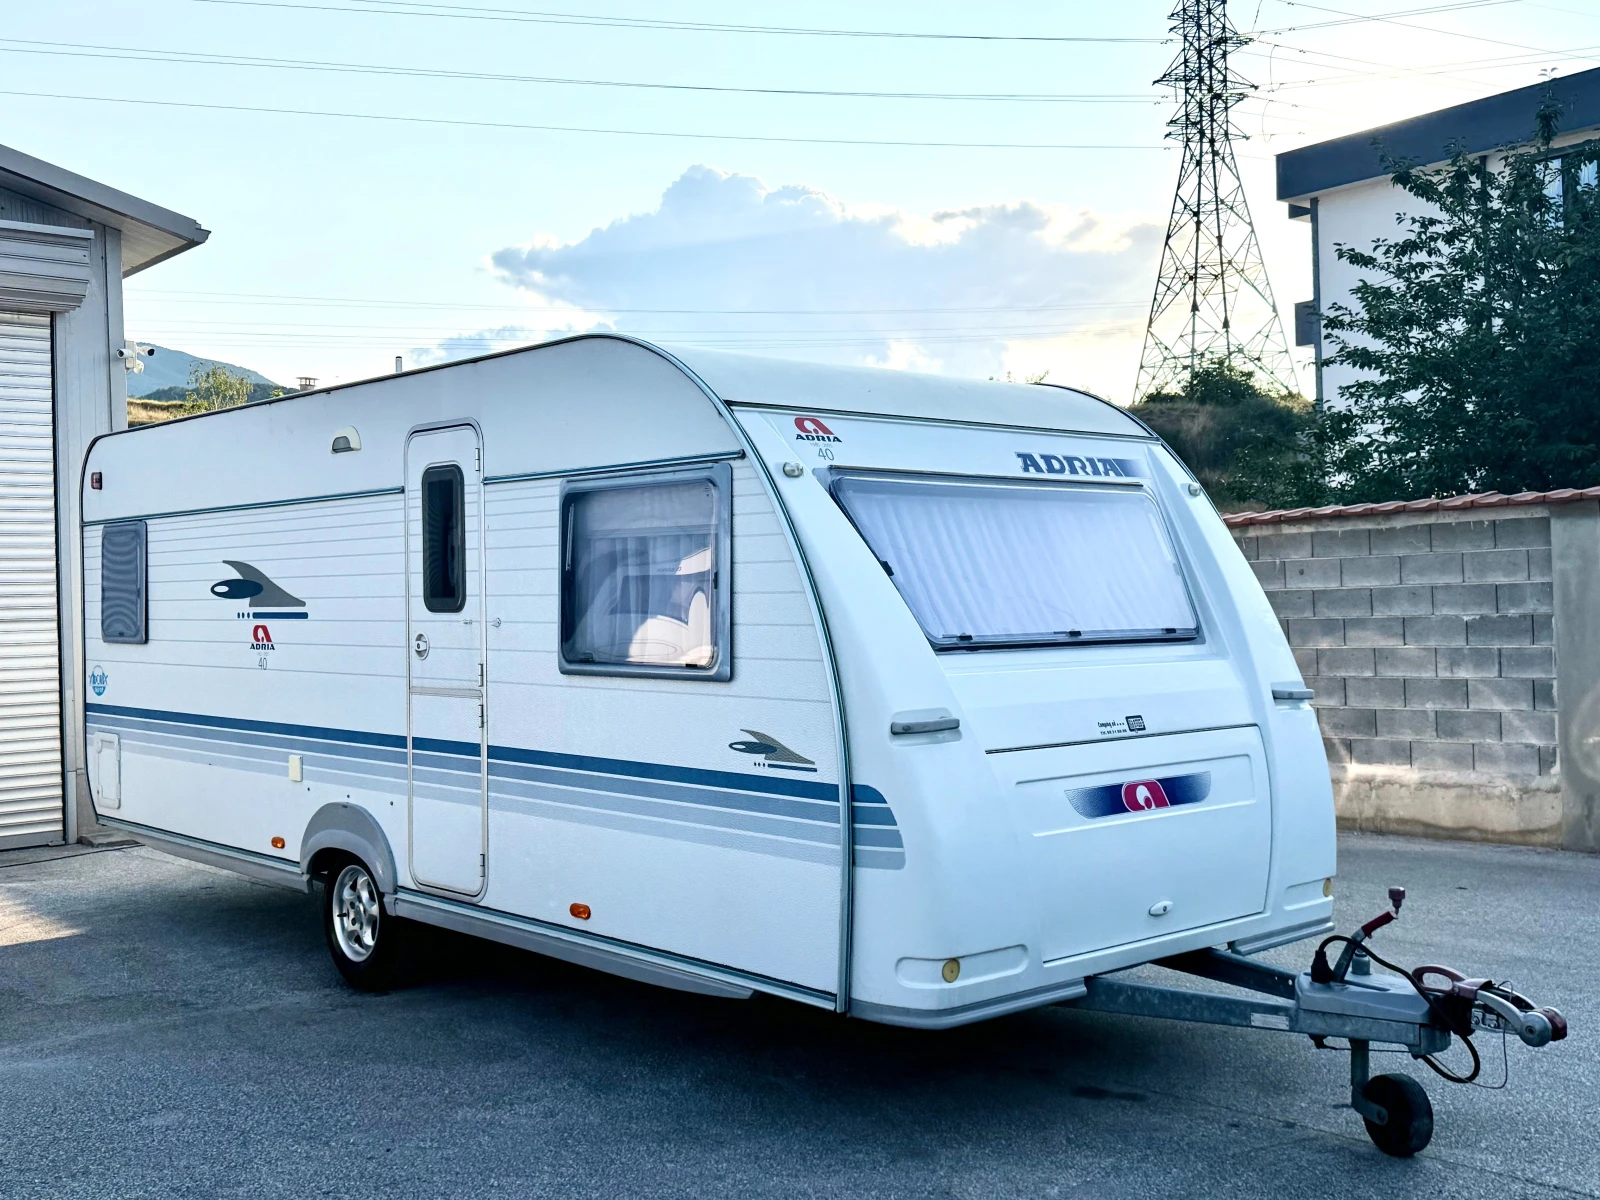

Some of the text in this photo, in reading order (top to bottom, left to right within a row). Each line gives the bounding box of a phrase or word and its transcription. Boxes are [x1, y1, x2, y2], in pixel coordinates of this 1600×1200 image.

[795, 433, 842, 443] ADRIA
[818, 447, 835, 461] 40
[1015, 452, 1125, 477] ADRIA
[249, 643, 276, 651] ADRIA
[258, 656, 268, 671] 40
